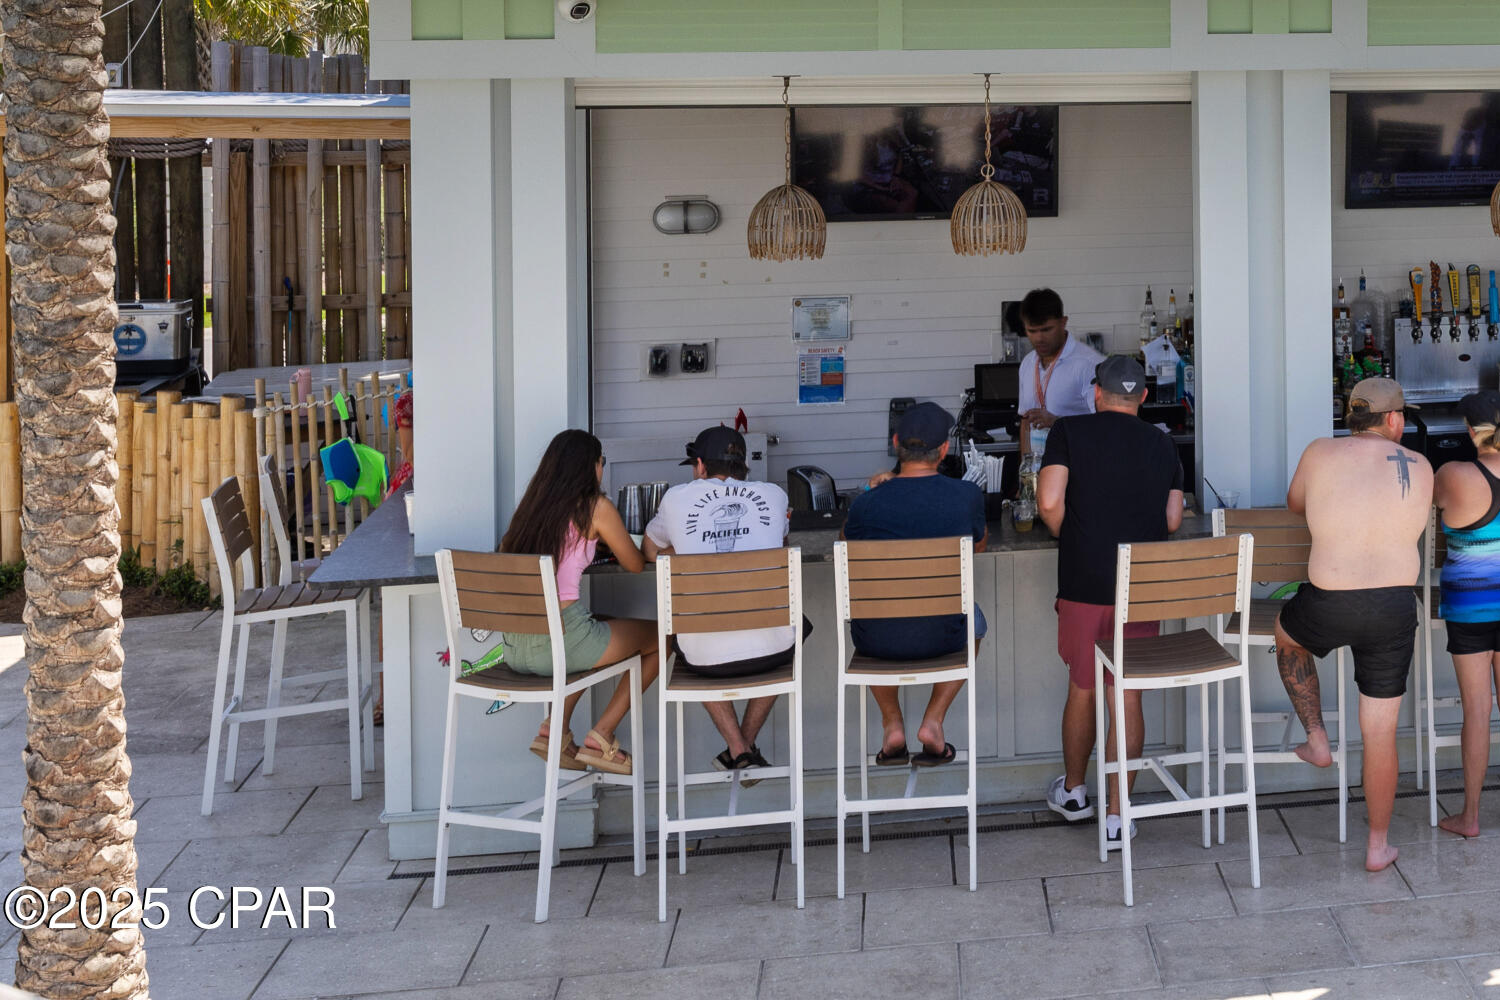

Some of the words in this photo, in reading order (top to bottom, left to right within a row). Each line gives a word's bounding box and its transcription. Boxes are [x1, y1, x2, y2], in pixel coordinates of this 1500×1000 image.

[686, 513, 699, 535] LIVE
[694, 489, 719, 508] LIFE
[725, 486, 770, 512] ANCHORS
[760, 515, 771, 526] UP
[702, 527, 750, 542] PACIFICO
